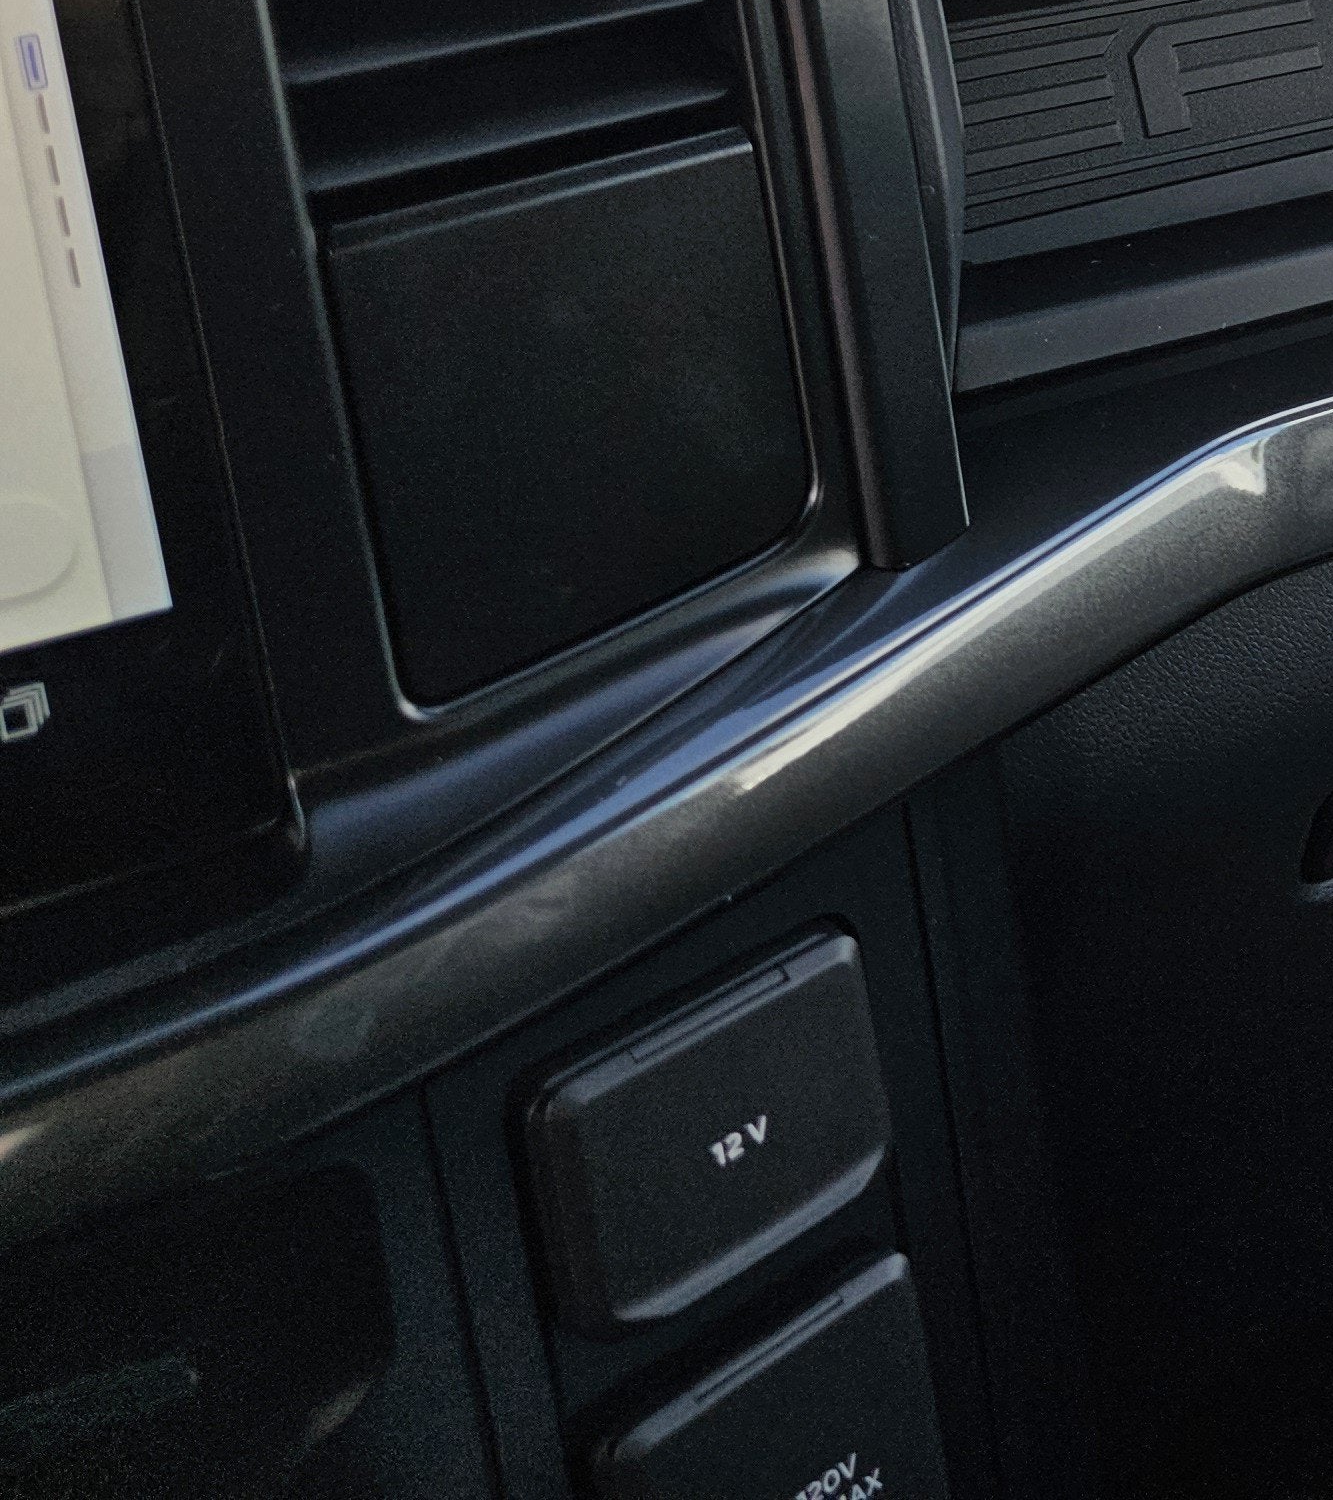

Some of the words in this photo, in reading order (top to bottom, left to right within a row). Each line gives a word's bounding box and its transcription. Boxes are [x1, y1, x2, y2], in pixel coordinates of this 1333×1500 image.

[711, 1131, 745, 1167] 12
[743, 1114, 767, 1145] V
[839, 1466, 884, 1500] AX
